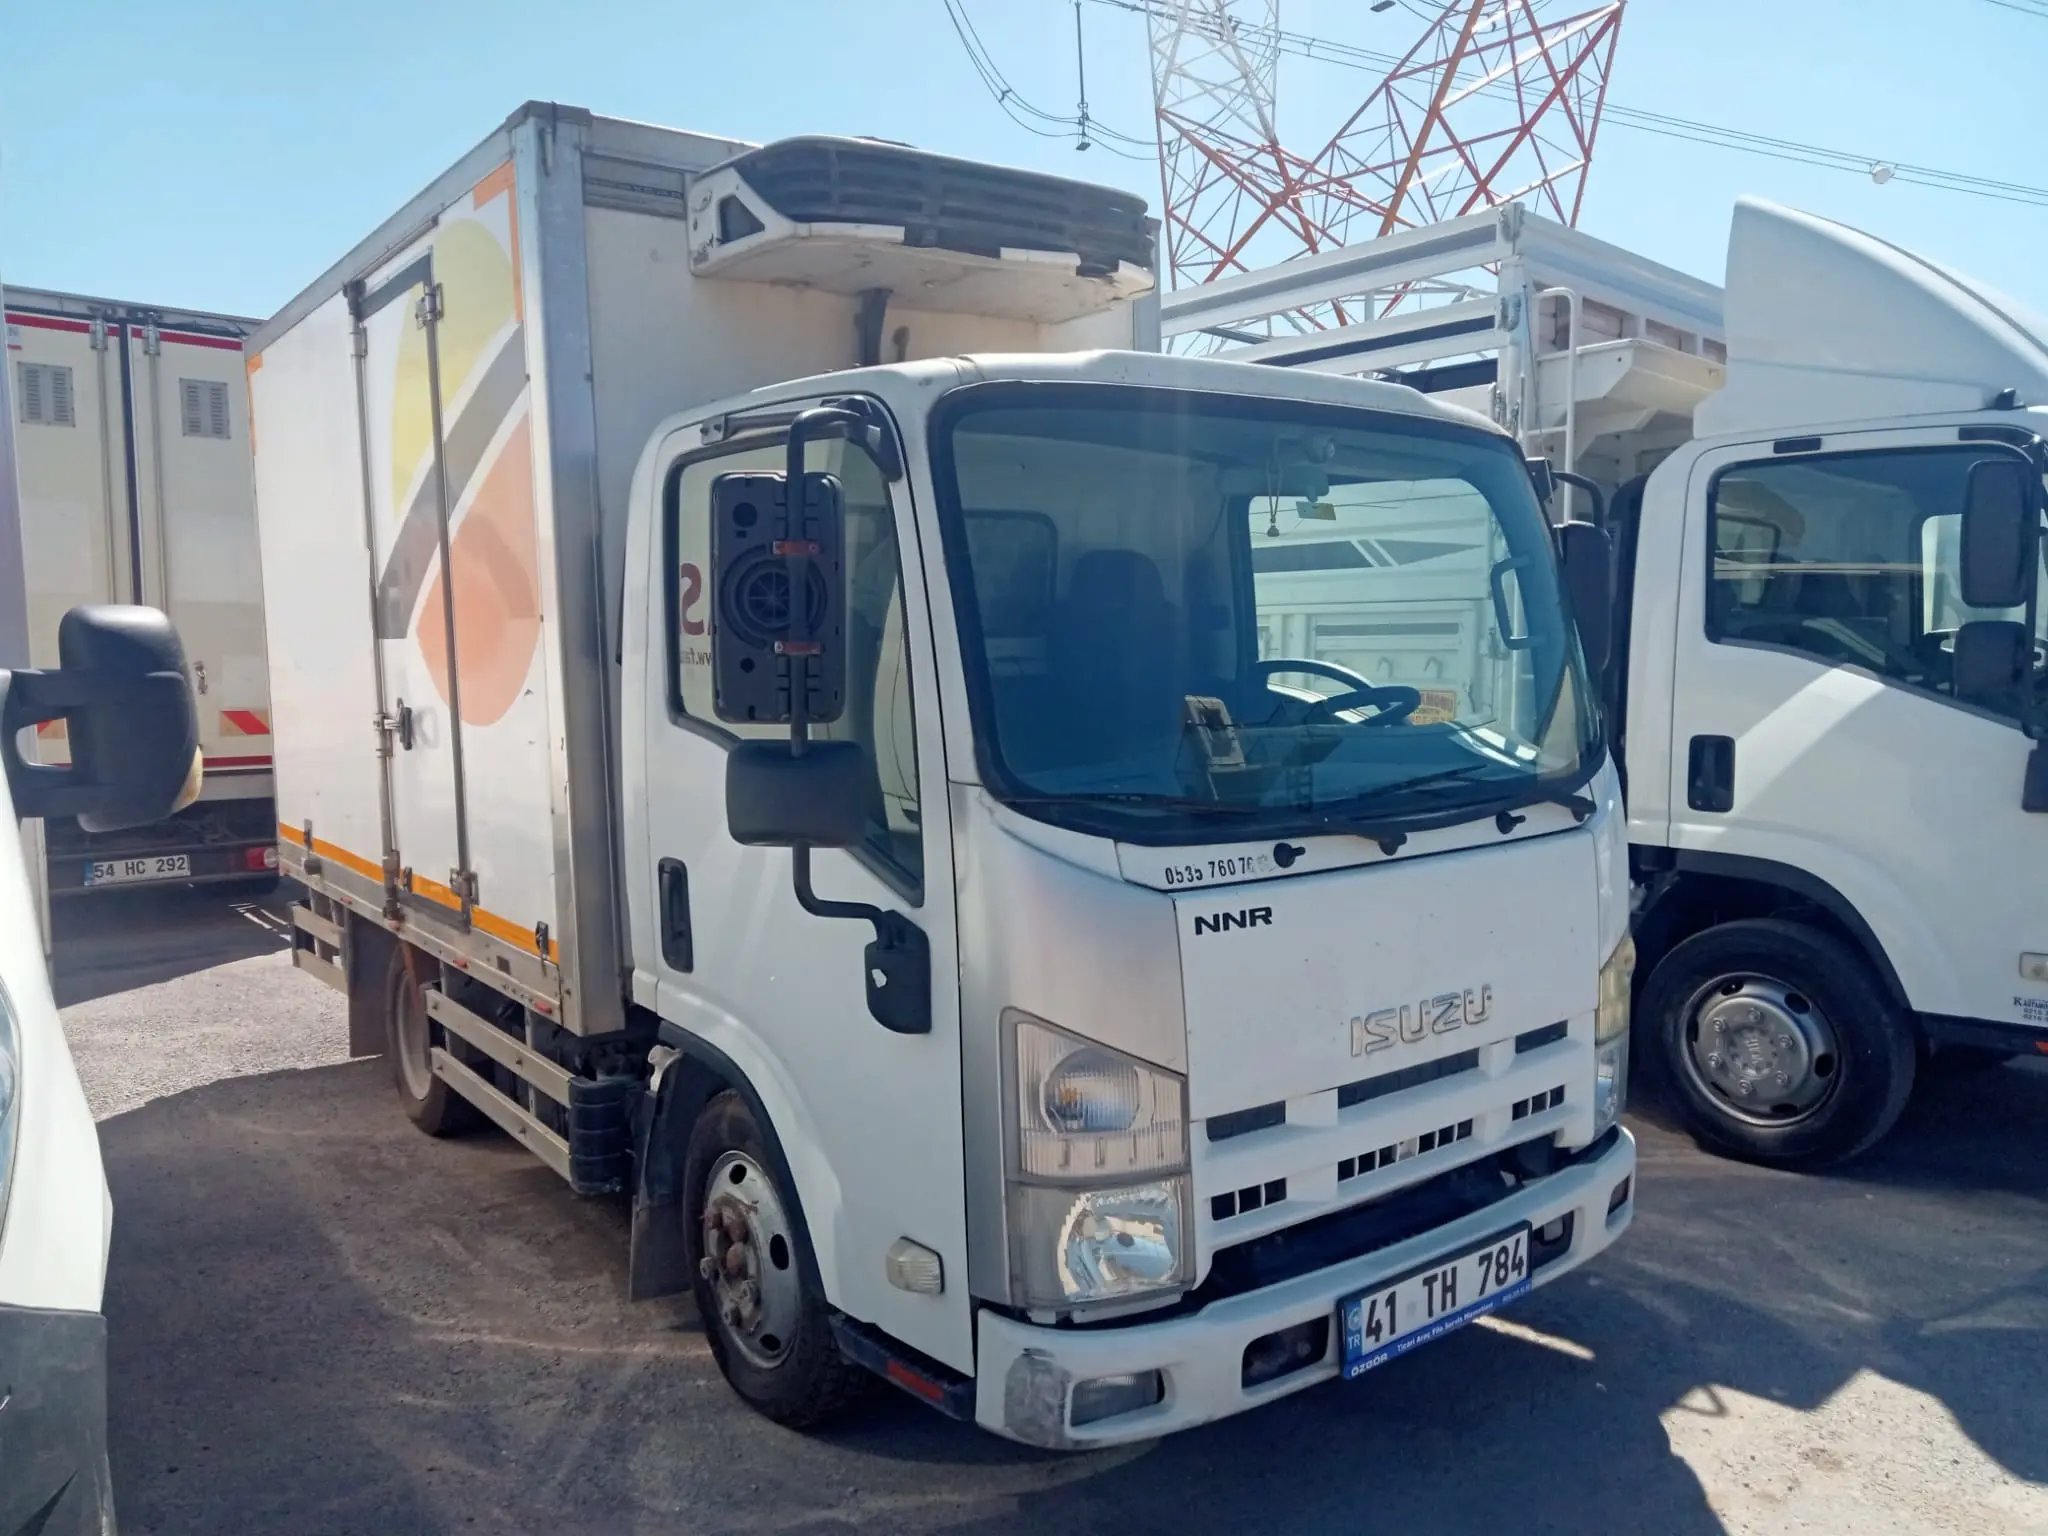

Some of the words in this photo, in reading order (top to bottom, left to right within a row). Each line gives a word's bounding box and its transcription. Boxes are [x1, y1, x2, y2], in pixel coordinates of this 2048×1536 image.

[94, 863, 115, 879] 54
[125, 861, 146, 876] HC
[156, 857, 186, 873] 292
[1208, 858, 1236, 878] 760
[1194, 906, 1272, 936] NNR
[1350, 983, 1493, 1058] ISUZU
[1365, 1291, 1397, 1343] 41
[1422, 1266, 1458, 1318] TH
[1478, 1237, 1524, 1297] 784
[1348, 1334, 1361, 1350] TR
